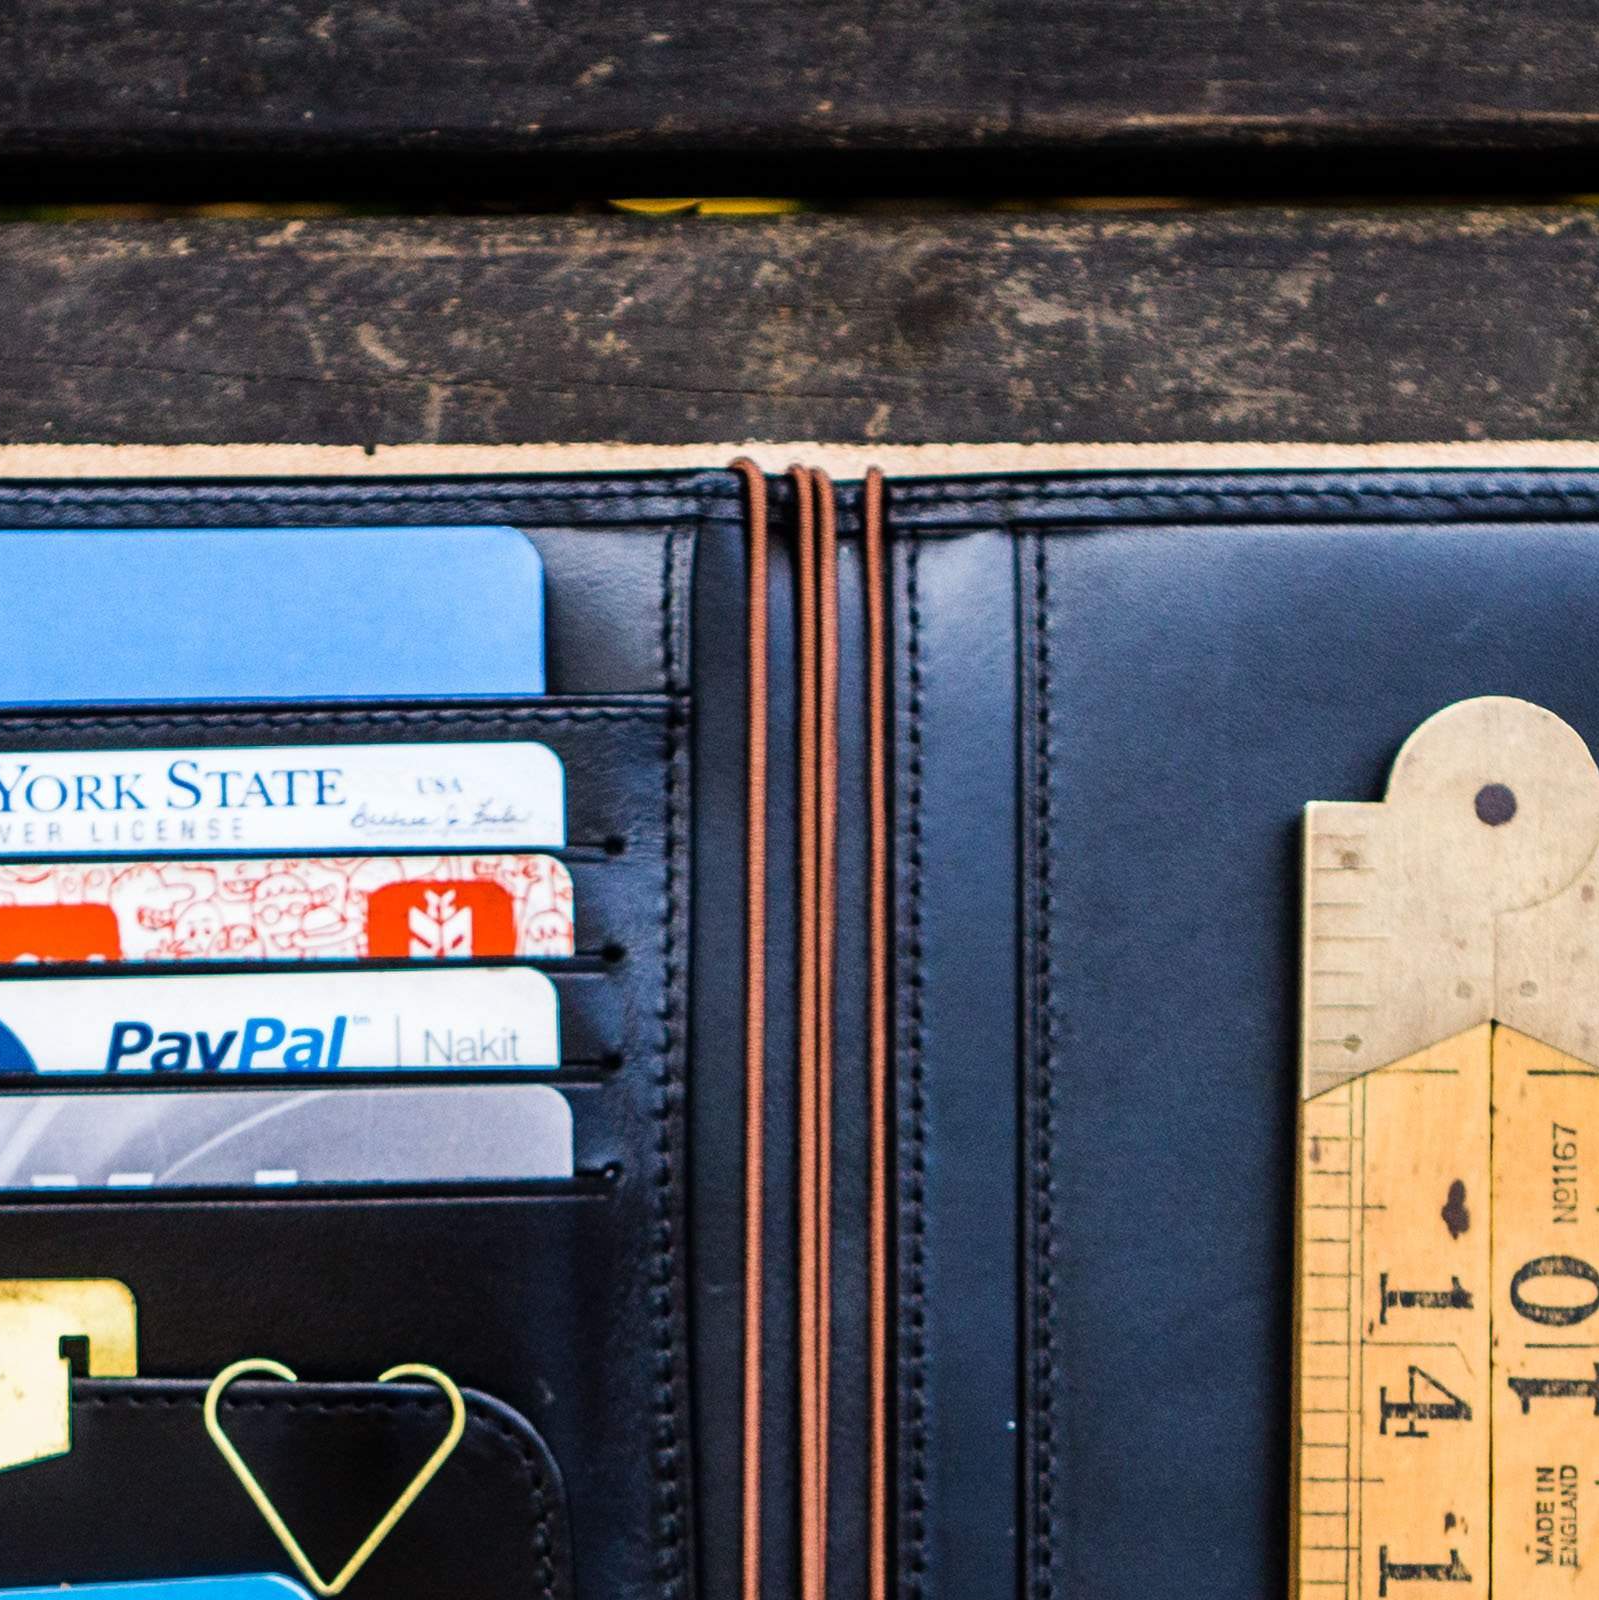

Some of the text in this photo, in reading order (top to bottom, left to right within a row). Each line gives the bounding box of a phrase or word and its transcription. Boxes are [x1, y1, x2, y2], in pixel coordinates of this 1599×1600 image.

[166, 760, 348, 809] STATE
[90, 815, 245, 844] LICENSE
[106, 1015, 347, 1073] PayPal
[423, 1027, 520, 1065] Nakit
[1536, 1466, 1556, 1566] MADE IN
[1559, 1464, 1578, 1568] ENGLAND
